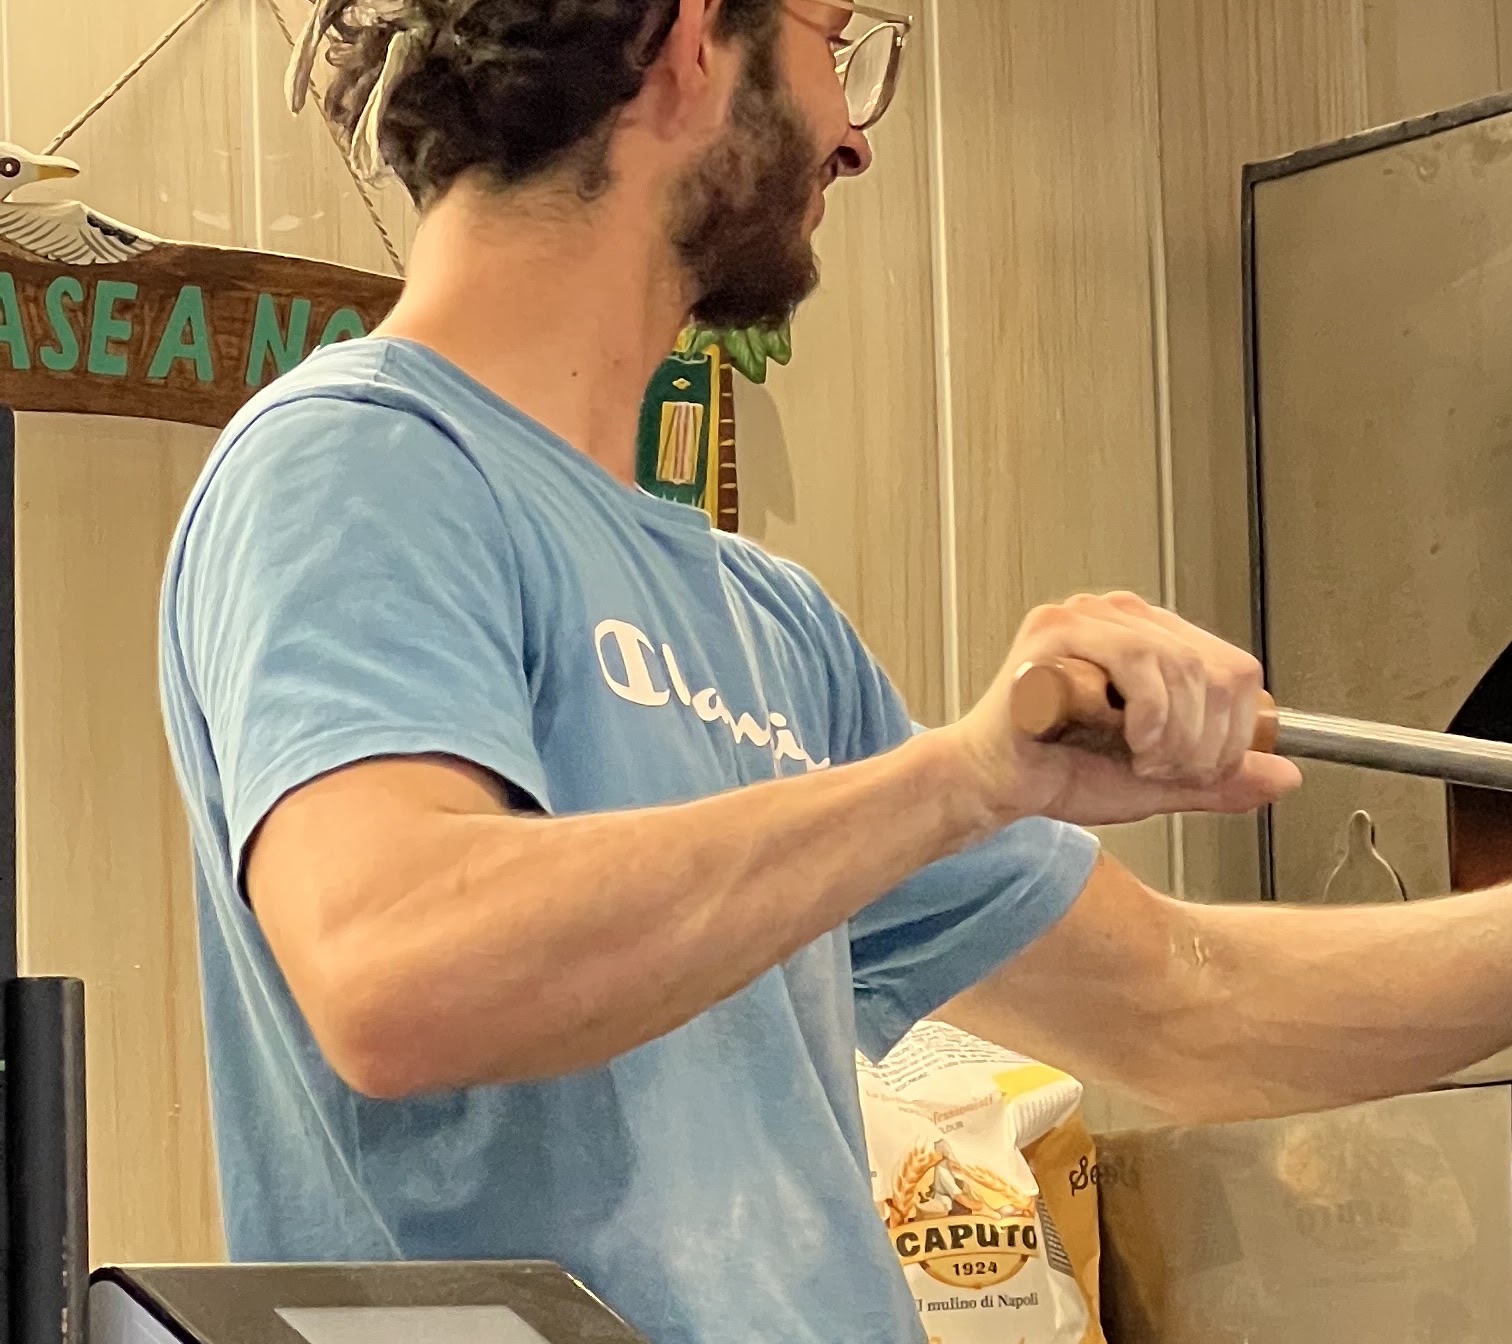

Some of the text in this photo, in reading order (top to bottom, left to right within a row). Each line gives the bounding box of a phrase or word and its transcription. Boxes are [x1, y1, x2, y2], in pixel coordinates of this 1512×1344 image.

[147, 285, 214, 384] A
[895, 1222, 1038, 1258] CAPUTO
[952, 1260, 998, 1277] 1924
[927, 1296, 978, 1312] mulino
[980, 1294, 994, 1309] di
[997, 1292, 1039, 1311] Napoli
